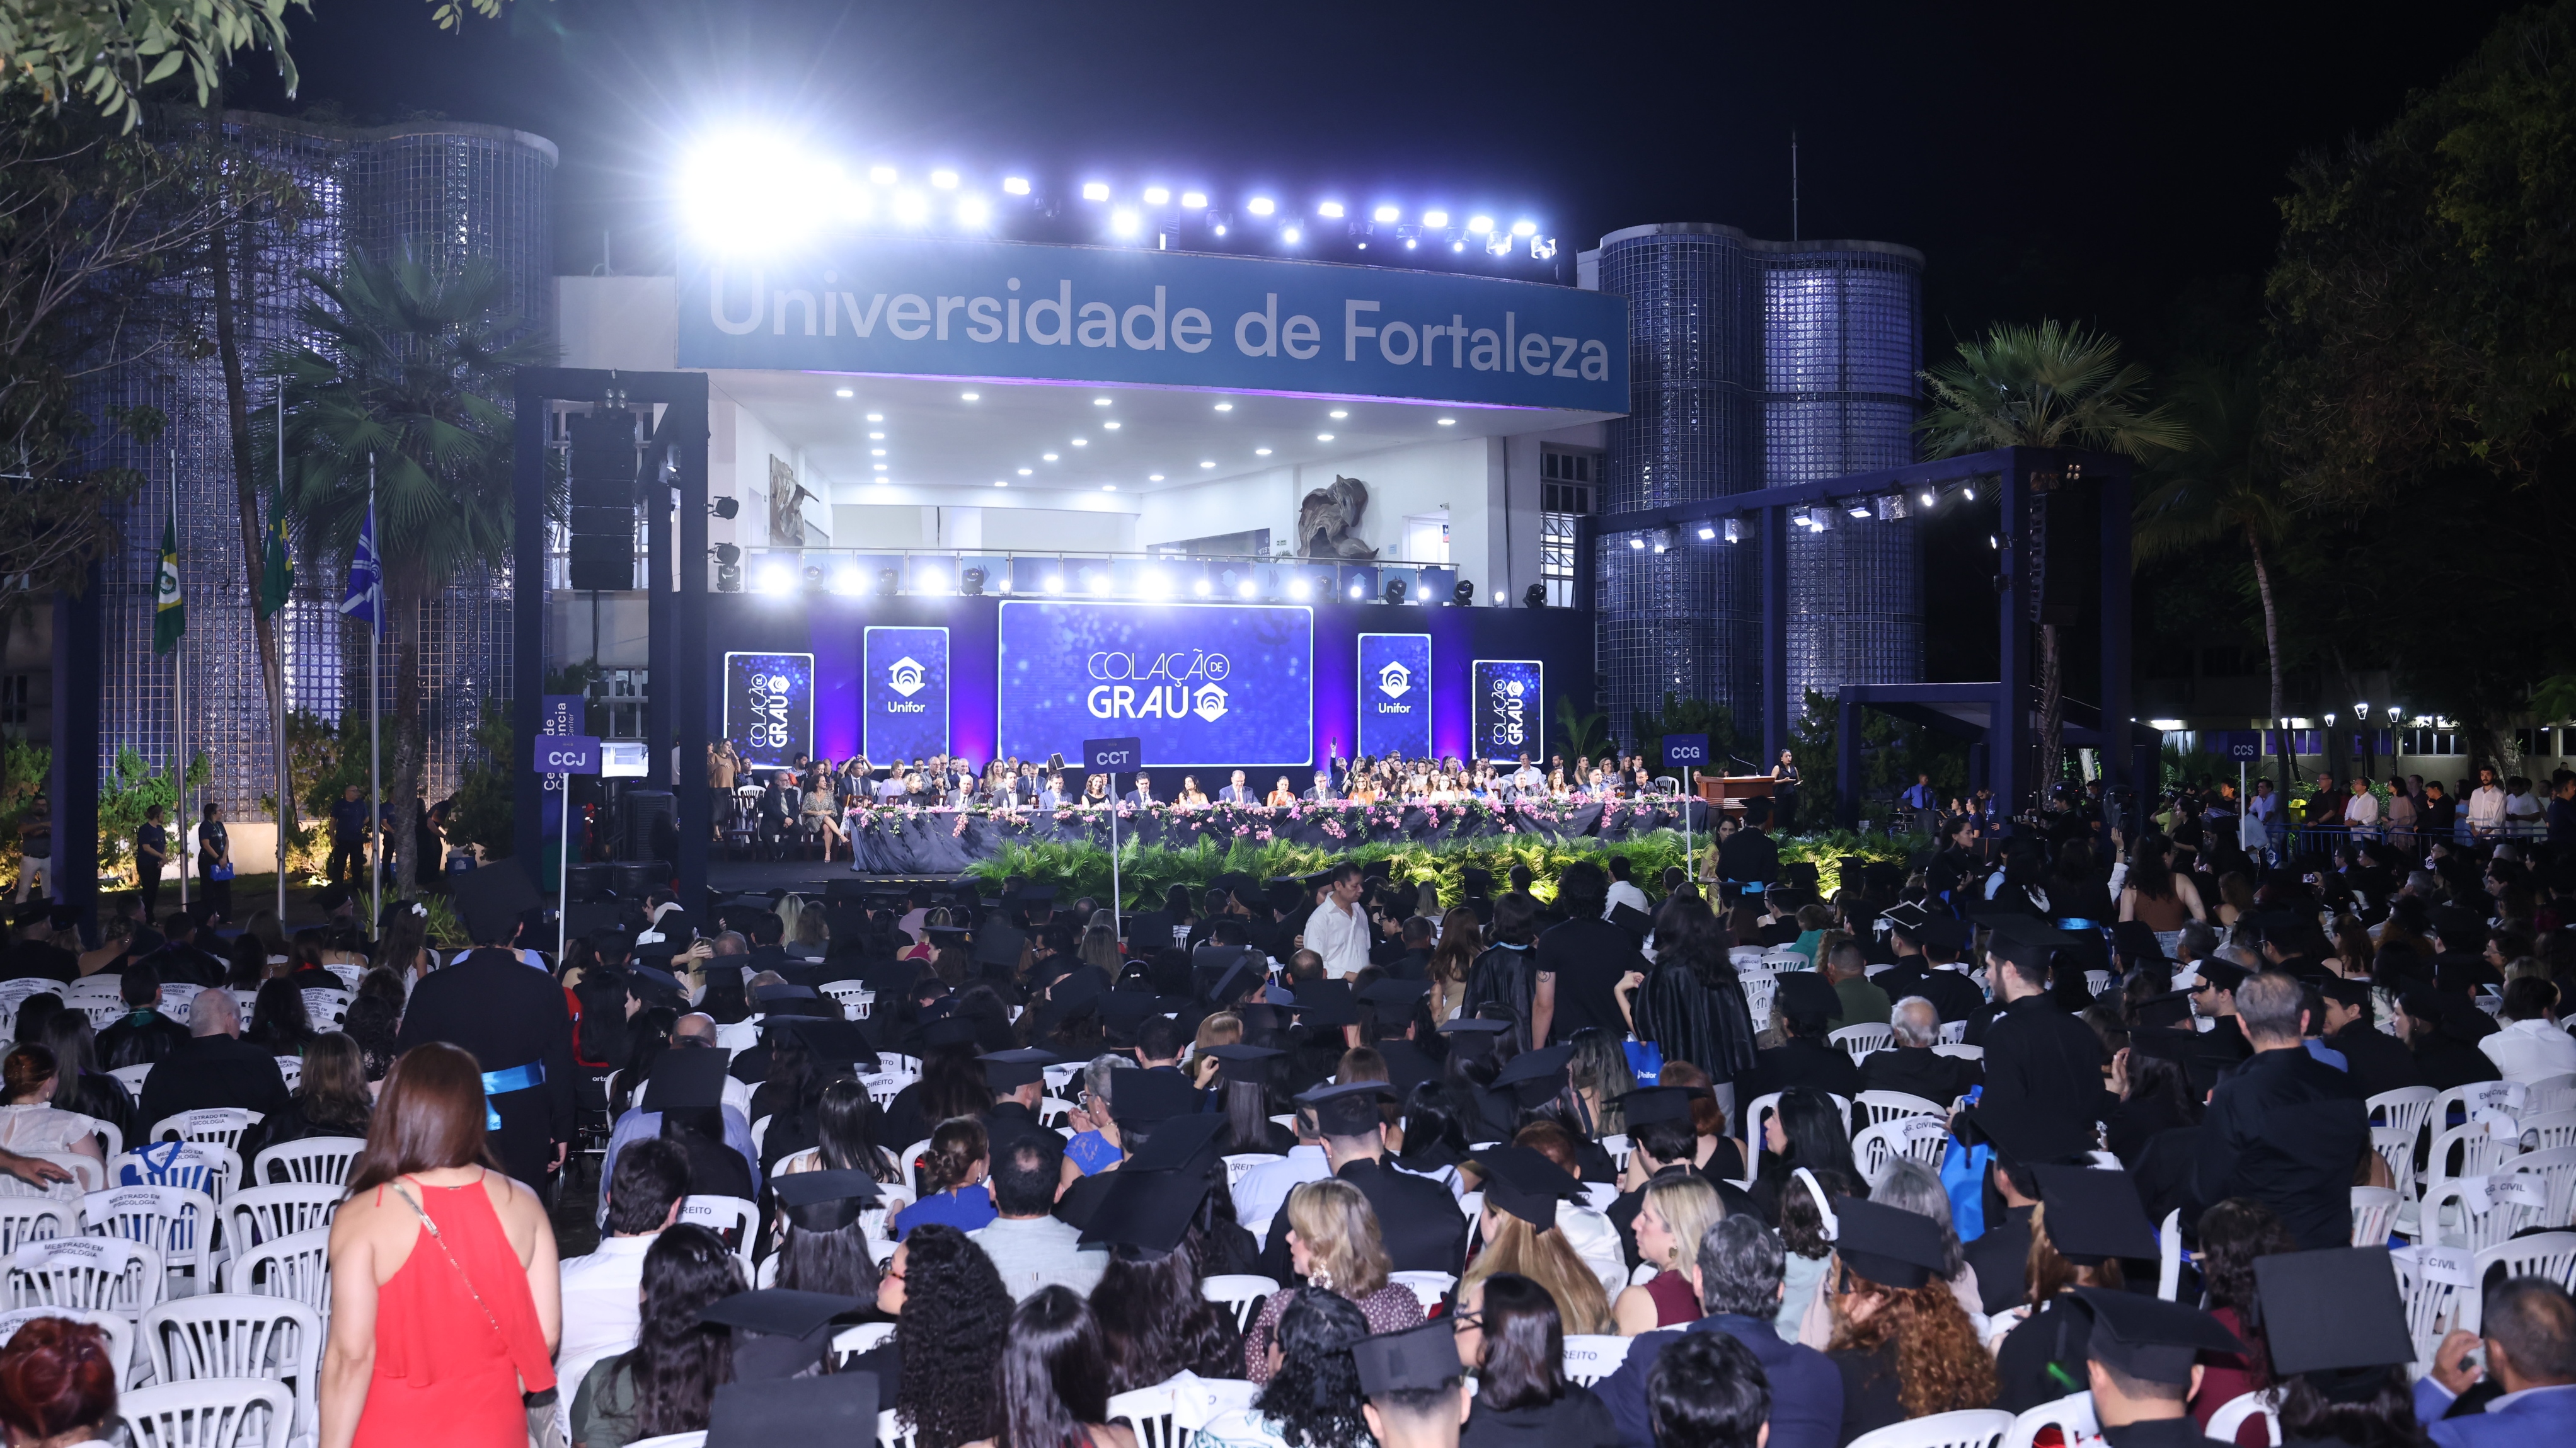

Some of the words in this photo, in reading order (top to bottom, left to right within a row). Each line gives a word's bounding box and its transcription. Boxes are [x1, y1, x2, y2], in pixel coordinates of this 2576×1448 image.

[710, 267, 1212, 353] Universidade
[1234, 292, 1321, 360] de
[1345, 299, 1609, 381] Fortaleza
[1088, 648, 1230, 688] COLAÇÃO
[1210, 662, 1223, 672] DE
[888, 701, 926, 713] Unifor
[1087, 684, 1189, 719] GRAU
[749, 674, 771, 748] COLAÇÃO
[1378, 702, 1412, 713] Unifor
[1492, 679, 1509, 745] COLAÇÃO
[769, 695, 788, 748] GRAU
[1507, 698, 1524, 745] GRAU
[1671, 746, 1700, 759] CCG
[2233, 745, 2253, 756] CCS
[548, 751, 586, 766] CCJ
[1096, 750, 1129, 766] CCT
[866, 1079, 894, 1088] DIREITO
[1916, 1122, 1937, 1130] CIVIL
[157, 1149, 193, 1158] MESADO
[2500, 1183, 2526, 1192] CIVIL
[109, 1193, 149, 1204] MESTRADO
[113, 1199, 156, 1209] PSICOLOGIA
[682, 1206, 712, 1215] REITO
[44, 1242, 91, 1250] MESTRADO
[48, 1248, 98, 1258] PSICOLOGIA
[2429, 1257, 2458, 1270] CIVIL
[1563, 1350, 1597, 1360] REITO
